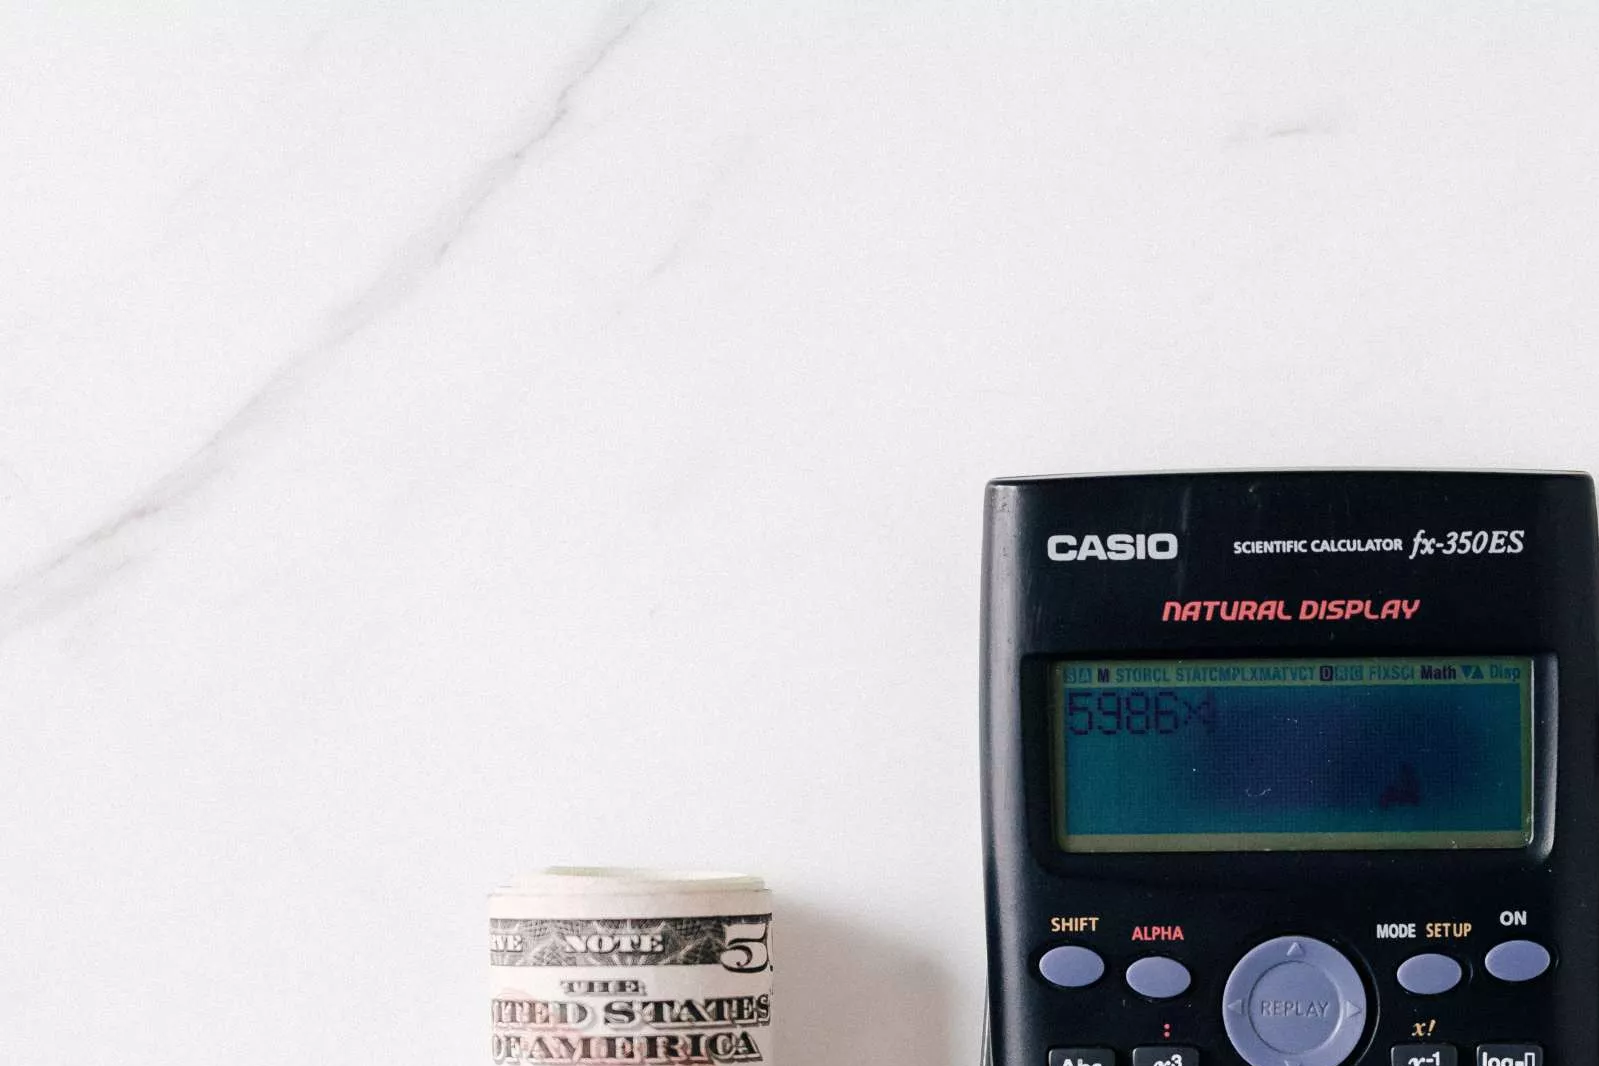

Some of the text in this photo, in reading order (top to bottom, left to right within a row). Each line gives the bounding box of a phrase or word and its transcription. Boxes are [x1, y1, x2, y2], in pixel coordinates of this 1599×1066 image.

[1048, 533, 1178, 561] CASIO
[1234, 530, 1524, 559] SCIENTIFIC CALCULATOR fx-350ES
[1163, 600, 1420, 621] NATURAL DISPLAY
[1421, 665, 1456, 680] Math
[1051, 917, 1099, 931] SHIFT
[1500, 911, 1526, 926] ON
[1132, 926, 1184, 940] ALPHA
[1377, 923, 1471, 938] MODE SETUP
[563, 934, 664, 953] NOTE
[561, 980, 647, 996] THE
[603, 994, 770, 1028] STATES
[1260, 999, 1329, 1018] REPLAY
[527, 1030, 763, 1065] AMERICA
